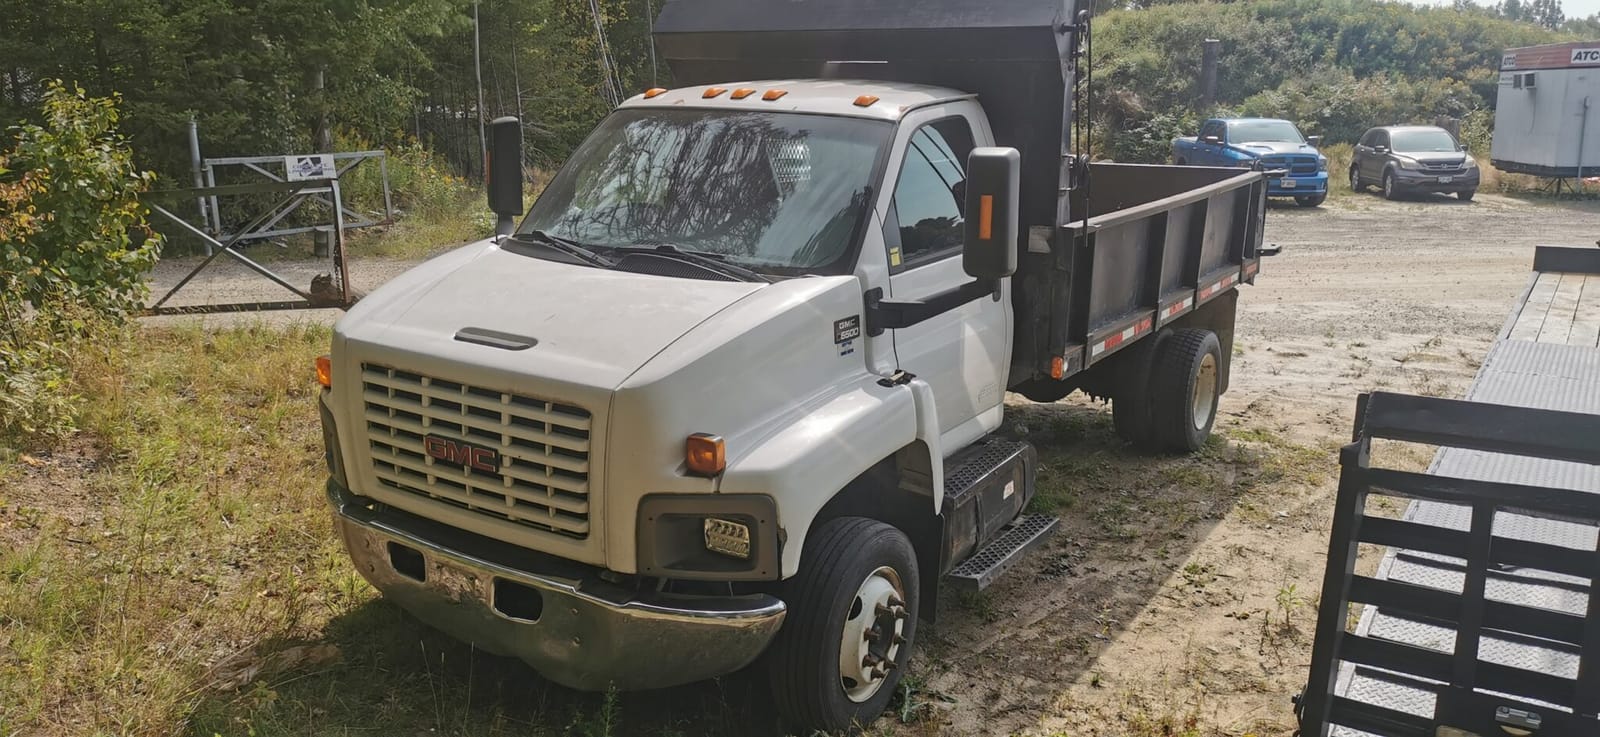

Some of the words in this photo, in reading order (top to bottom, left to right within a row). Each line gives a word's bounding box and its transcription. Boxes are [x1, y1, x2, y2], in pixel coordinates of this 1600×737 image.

[1572, 51, 1600, 62] ATC
[839, 318, 856, 330] GMC
[425, 435, 496, 473] GMC
